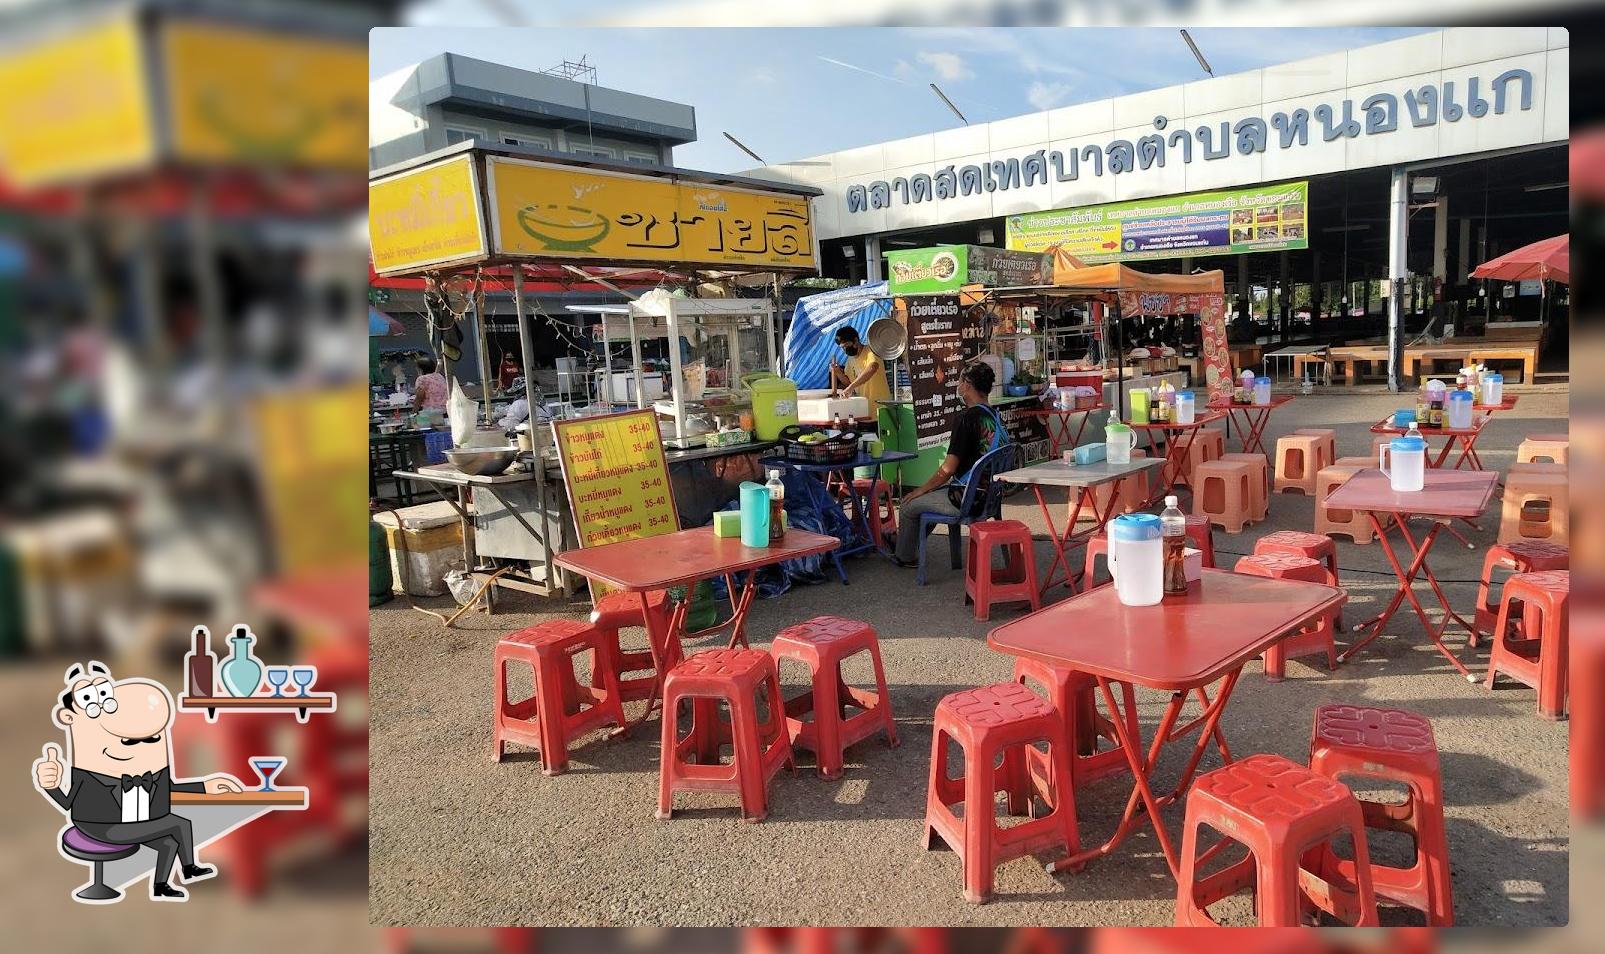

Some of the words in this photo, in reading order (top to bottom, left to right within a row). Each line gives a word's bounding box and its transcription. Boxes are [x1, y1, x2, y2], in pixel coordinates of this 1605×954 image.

[846, 68, 1533, 214] ตลาดสดเทศบาลตำบลหนองแก
[910, 297, 958, 317] ก๋วยเตี๋ยวเรือ
[565, 430, 605, 444] ข้าวหมูแดง
[629, 422, 651, 434] 35-40
[569, 447, 603, 464] ข้าวมันไก่
[632, 441, 654, 453] 35-40
[636, 459, 658, 471] 35-40
[578, 487, 622, 503] บะหมี่หมูแดง
[640, 478, 662, 490] 35-40
[644, 496, 666, 508] 35-40
[648, 514, 669, 527] 35-40
